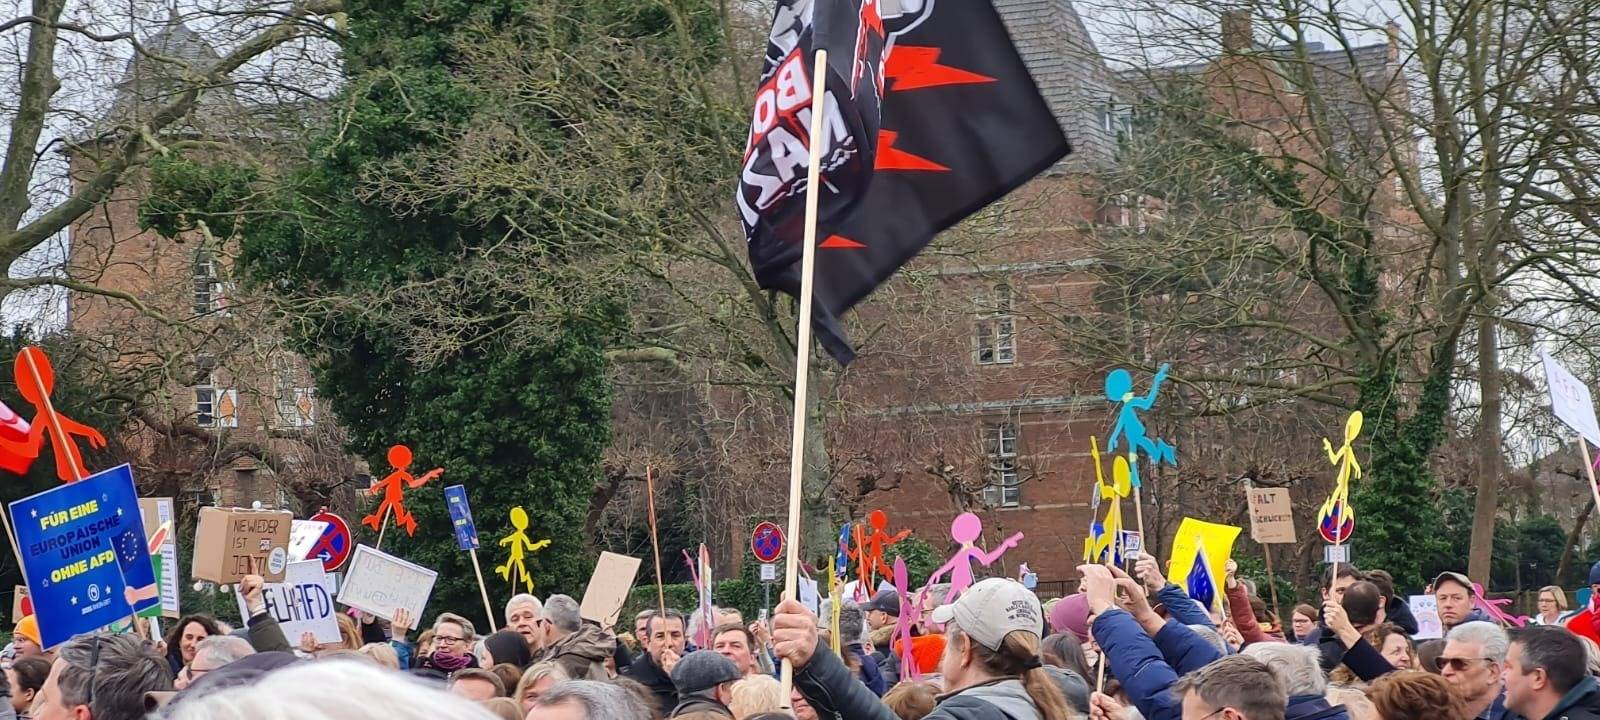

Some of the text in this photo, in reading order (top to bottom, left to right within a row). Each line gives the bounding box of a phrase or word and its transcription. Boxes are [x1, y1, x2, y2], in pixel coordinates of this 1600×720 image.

[40, 499, 99, 530] FÜR EINE
[60, 535, 101, 560] UNION
[232, 537, 248, 549] IST
[51, 549, 115, 583] OHNE AFD
